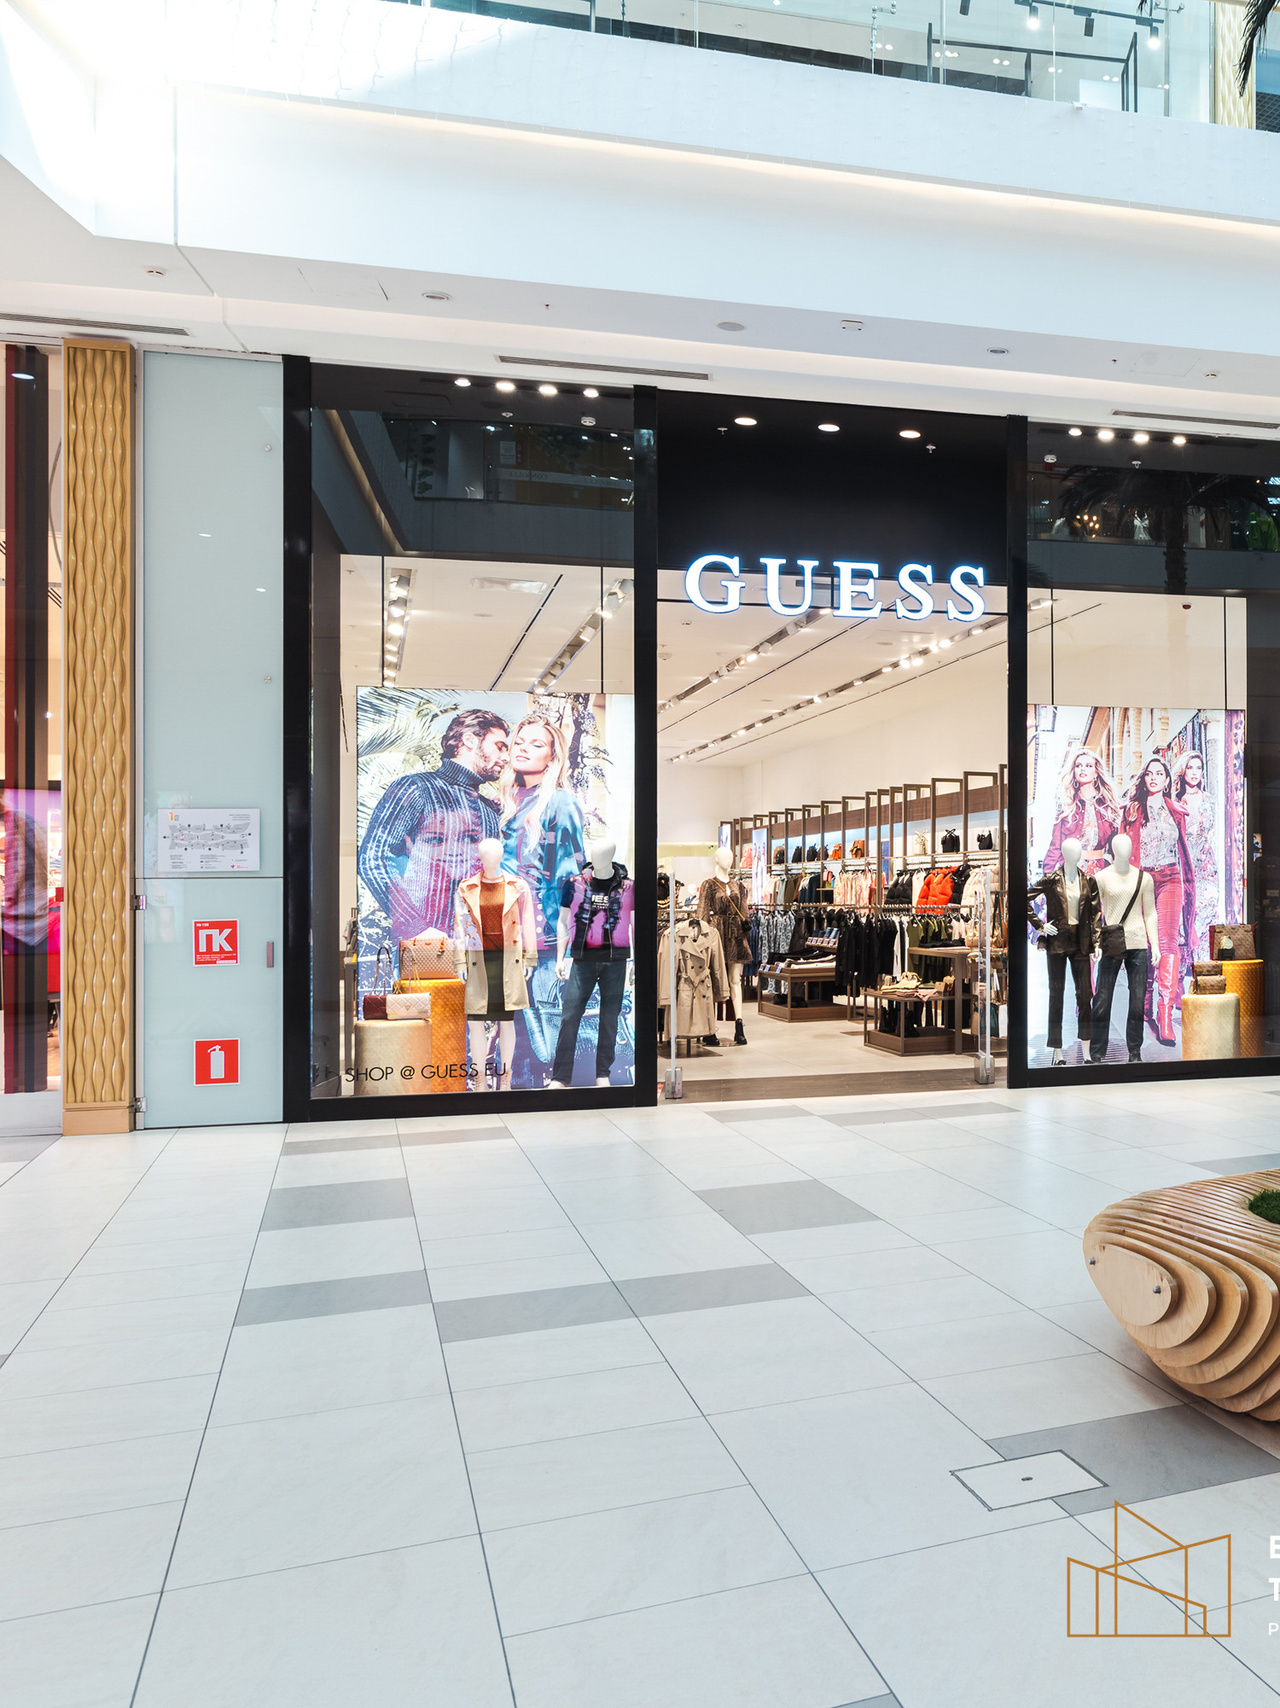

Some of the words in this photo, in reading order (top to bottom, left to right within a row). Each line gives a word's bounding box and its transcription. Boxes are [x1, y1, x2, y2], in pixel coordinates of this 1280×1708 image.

[685, 554, 986, 622] GUESS
[199, 928, 233, 952] ПК
[345, 1067, 394, 1082] SHOP
[400, 1065, 415, 1080] @
[421, 1063, 478, 1079] GUESS
[485, 1062, 506, 1077] EU
